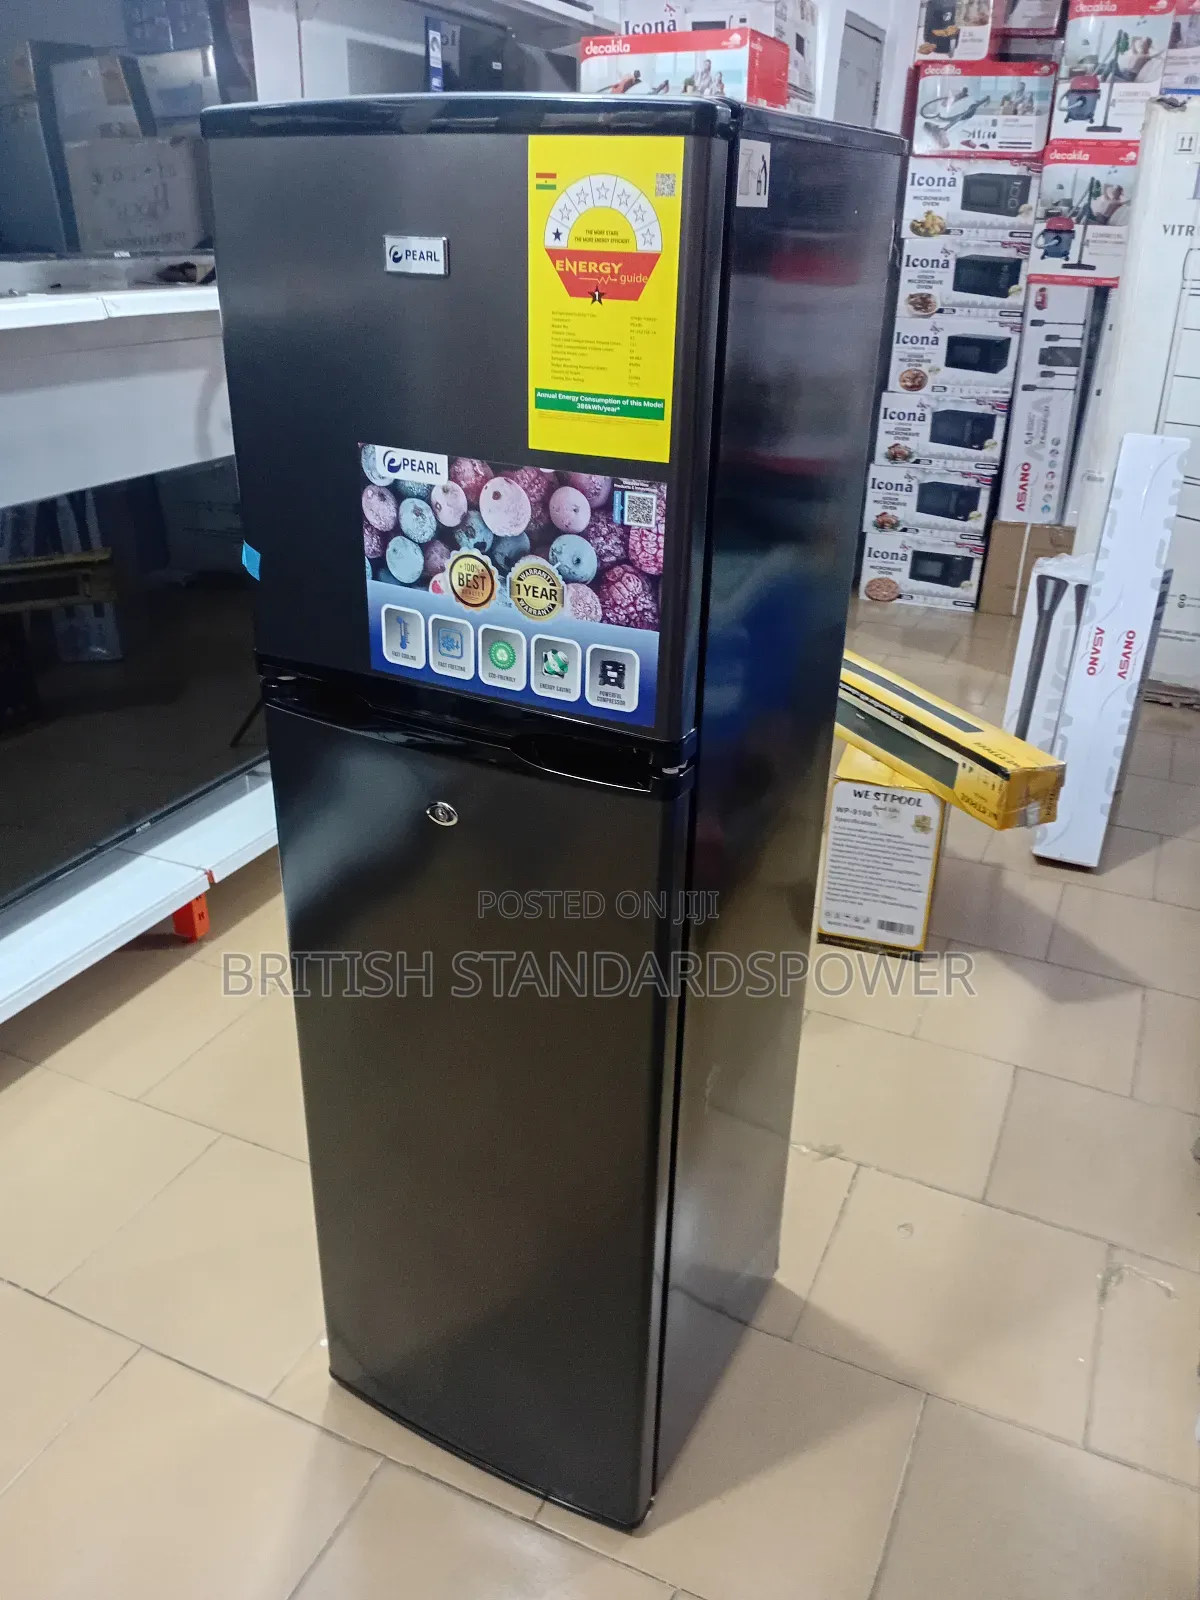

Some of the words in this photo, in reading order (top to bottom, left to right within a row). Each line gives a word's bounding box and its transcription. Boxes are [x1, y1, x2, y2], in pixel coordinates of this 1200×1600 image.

[624, 18, 677, 35] Icona
[585, 38, 631, 55] decakila
[1049, 150, 1090, 161] decakila
[910, 172, 957, 187] Icona
[405, 249, 440, 262] PEARL
[905, 254, 950, 269] Icona
[555, 257, 623, 276] ENERGY
[620, 273, 649, 285] guide
[895, 331, 940, 346] Icona
[536, 391, 557, 399] Annual
[558, 393, 579, 402] Energy
[580, 395, 620, 405] Consumption
[643, 401, 664, 409] Model
[882, 407, 926, 422] Icona
[402, 458, 441, 475] PEARL
[871, 477, 913, 493] Icona
[1016, 462, 1032, 512] ASANO
[867, 546, 908, 562] Icona
[464, 563, 480, 574] 100%
[519, 567, 555, 587] WARRANTY
[458, 572, 486, 591] BEST
[516, 583, 521, 595] 1
[523, 584, 558, 601] YEAR
[519, 599, 554, 617] WARRANTY
[1087, 627, 1105, 676] ASANO
[1117, 630, 1136, 680] ASANO
[540, 682, 555, 691] ENERGY
[853, 789, 923, 808] WESTPOOL
